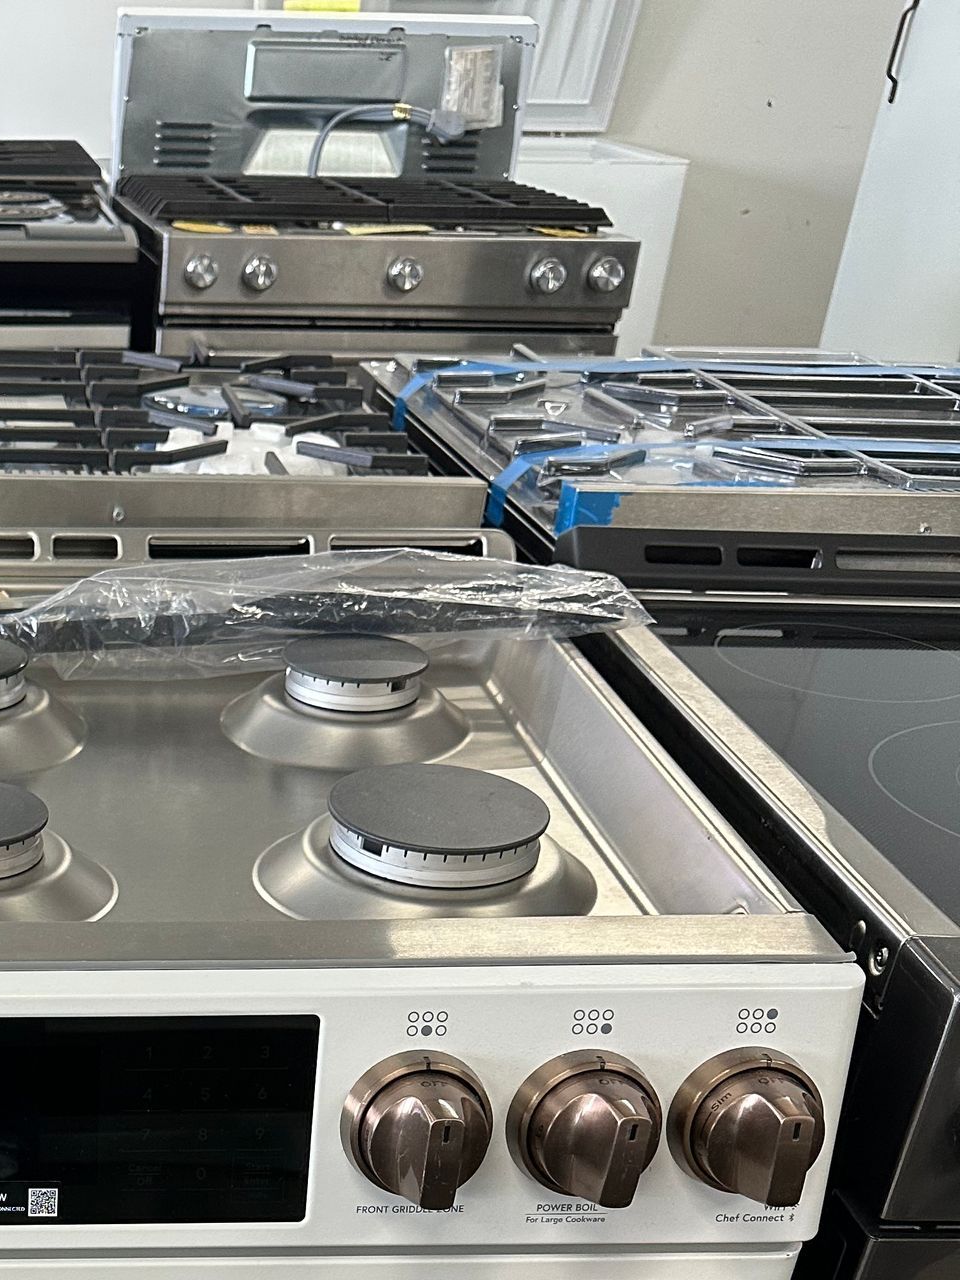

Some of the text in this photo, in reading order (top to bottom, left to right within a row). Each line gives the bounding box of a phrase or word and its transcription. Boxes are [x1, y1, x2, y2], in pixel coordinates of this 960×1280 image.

[356, 1205, 389, 1214] FRONT
[391, 1204, 434, 1214] GRIDDL
[536, 1203, 599, 1212] POWER BOIL
[525, 1215, 606, 1225] For Large Cookware
[715, 1213, 785, 1223] Chef Connect
